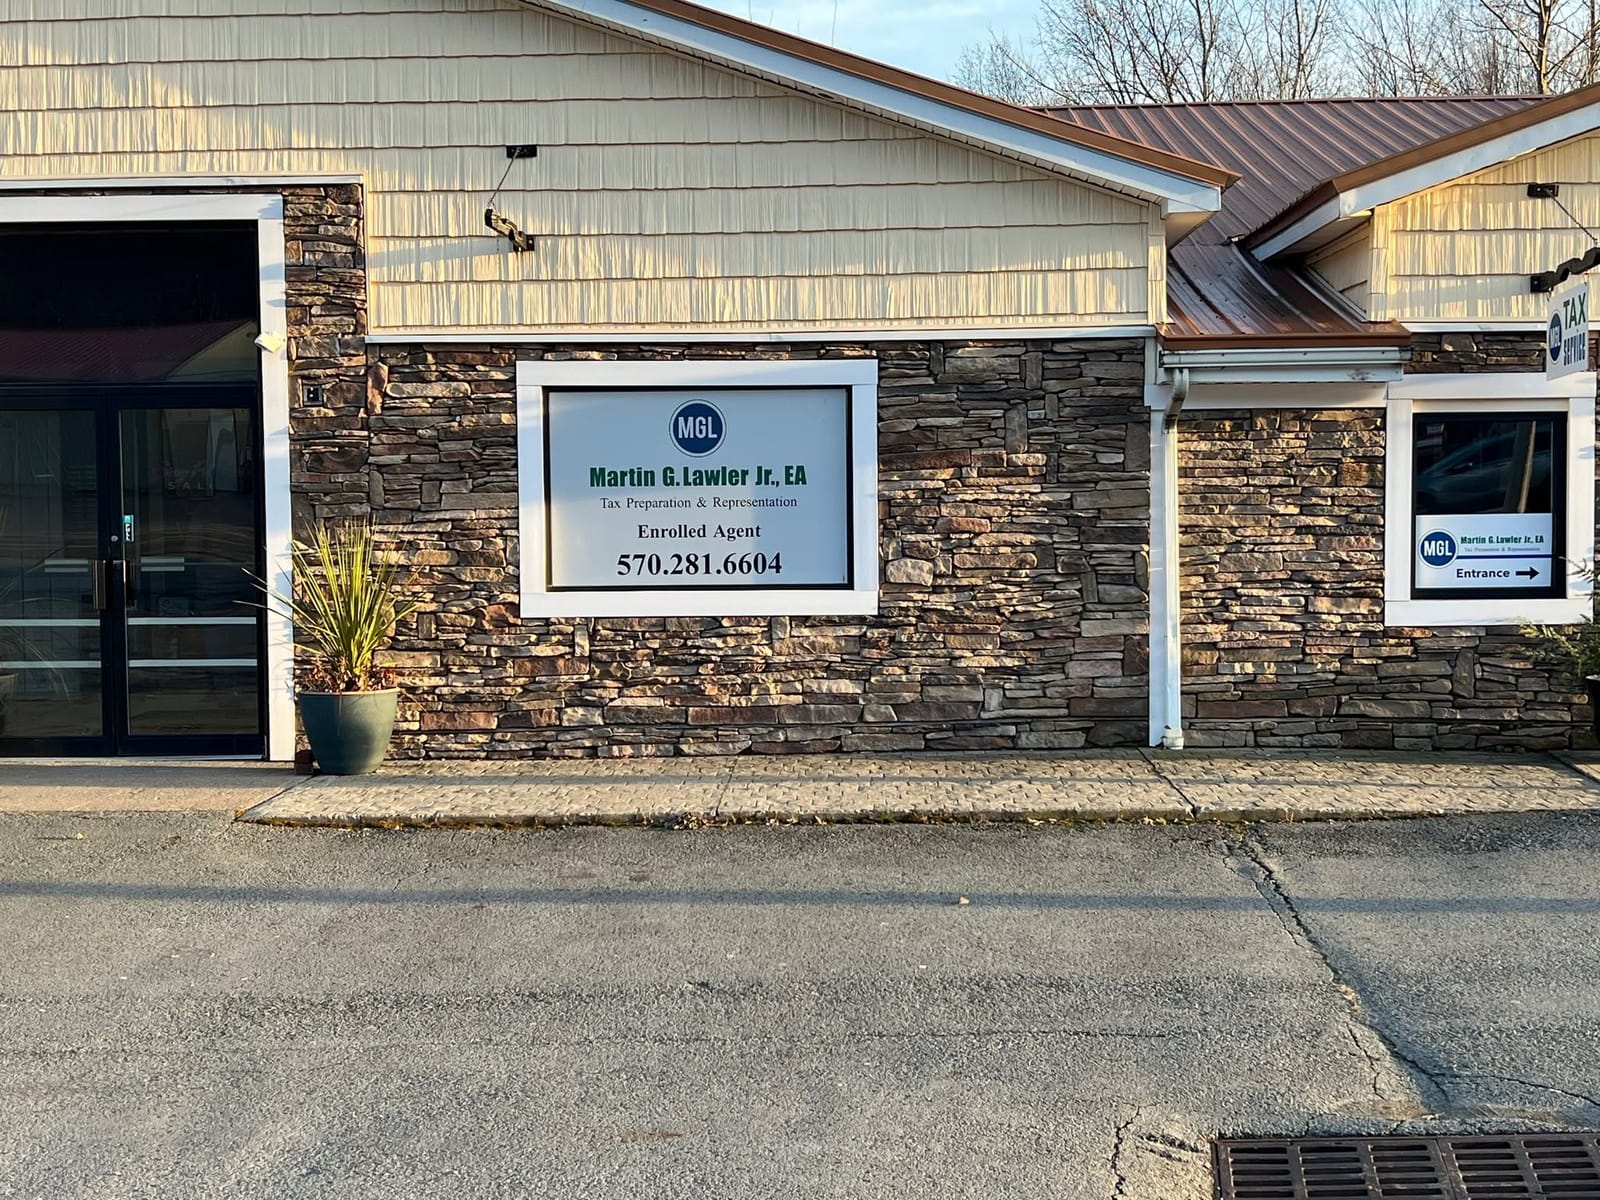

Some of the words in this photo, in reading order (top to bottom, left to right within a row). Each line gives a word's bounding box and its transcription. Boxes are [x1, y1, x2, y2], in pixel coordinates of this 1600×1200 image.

[1563, 292, 1586, 330] TAX
[678, 416, 718, 439] MGL
[589, 466, 656, 488] Martin
[755, 465, 780, 488] Jr.,
[784, 465, 808, 486] EA
[600, 497, 621, 509] Tax
[626, 497, 691, 512] Preparation
[696, 496, 707, 508] &
[713, 496, 798, 511] Representation
[638, 524, 707, 539] Enrolled
[713, 524, 762, 542] Agent
[1460, 535, 1486, 545] Martin
[1535, 535, 1544, 544] EA
[1423, 540, 1453, 557] MGL
[617, 552, 783, 576] 570.281.6604
[1456, 568, 1510, 579] Entrance
